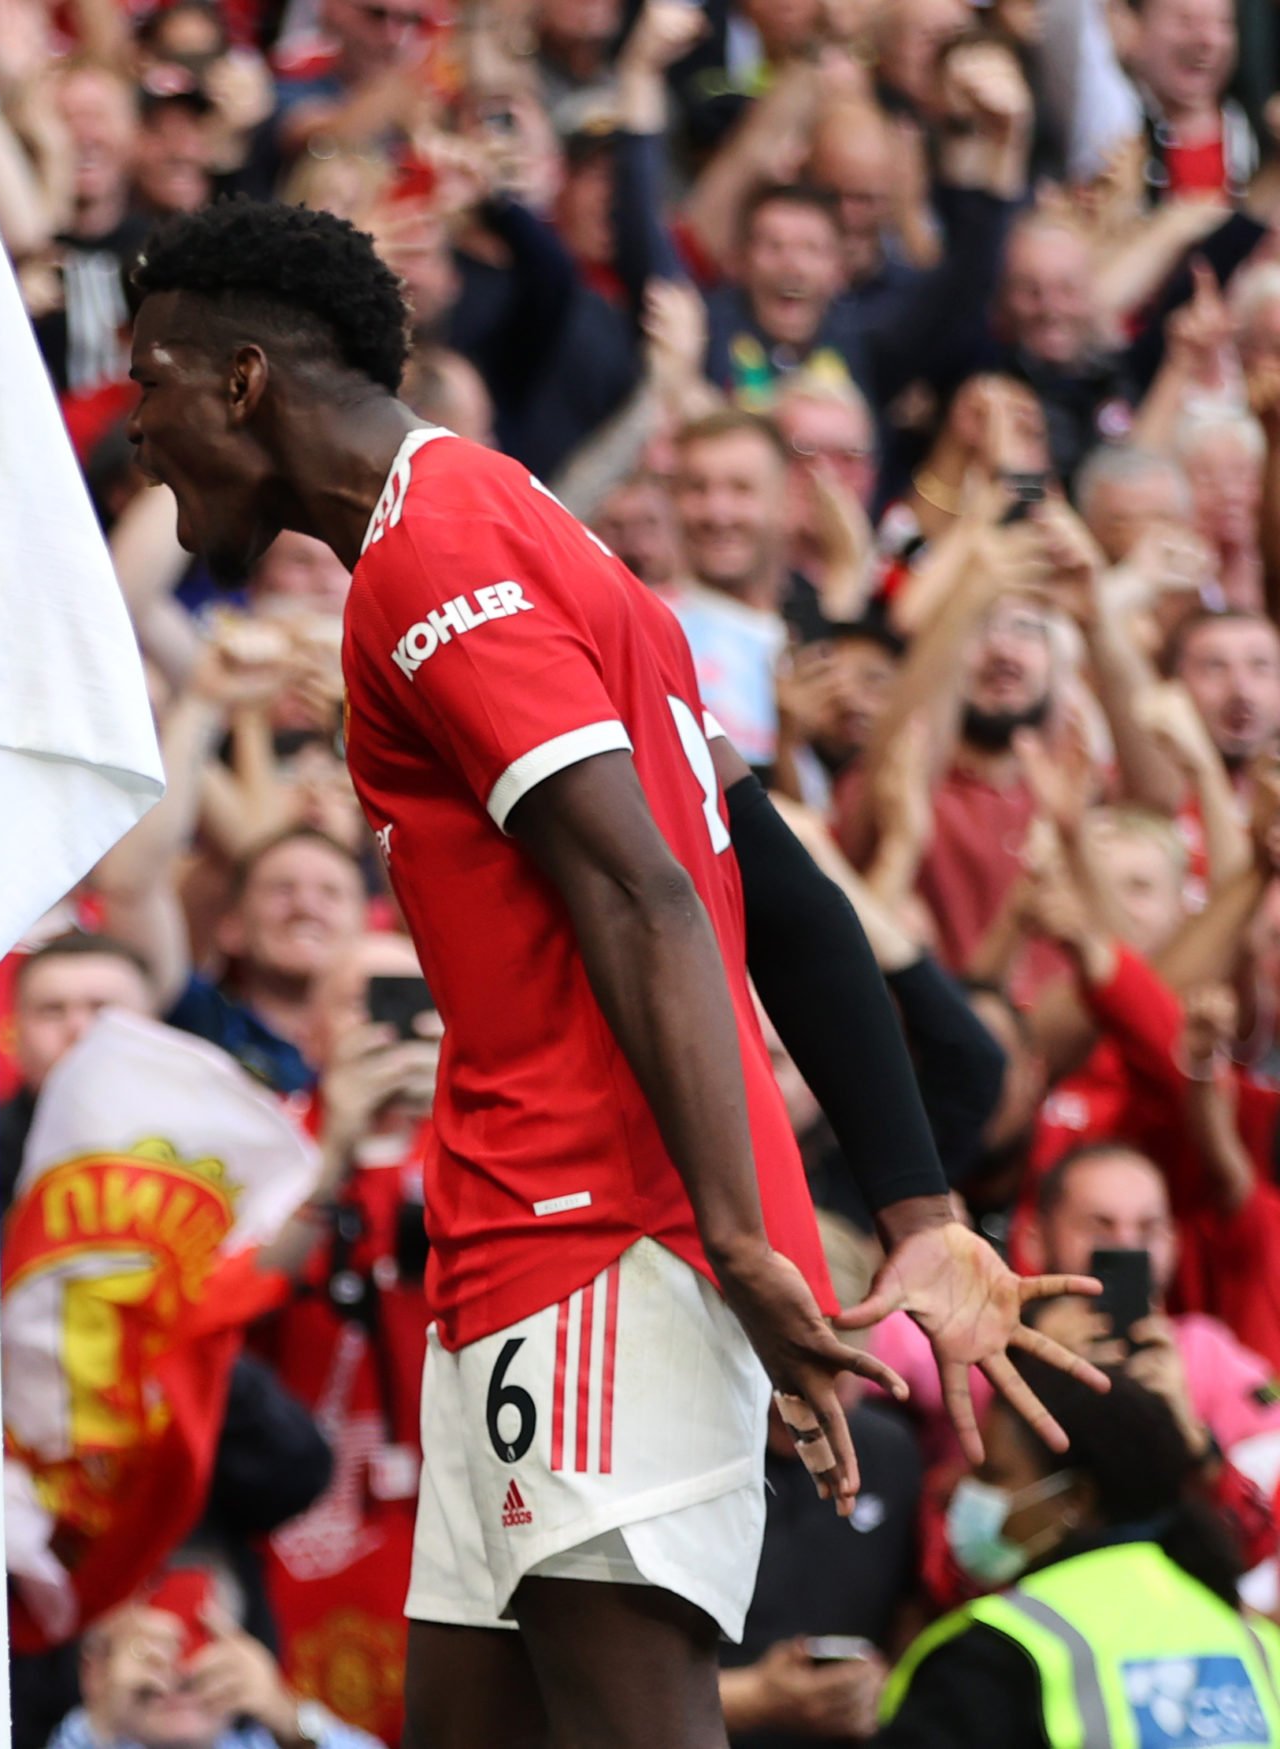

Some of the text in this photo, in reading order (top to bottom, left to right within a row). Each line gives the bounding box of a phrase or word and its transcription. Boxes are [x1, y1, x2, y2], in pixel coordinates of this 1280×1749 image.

[391, 580, 535, 682] KOHLER
[486, 1338, 536, 1463] 6
[502, 1511, 532, 1528] adidas
